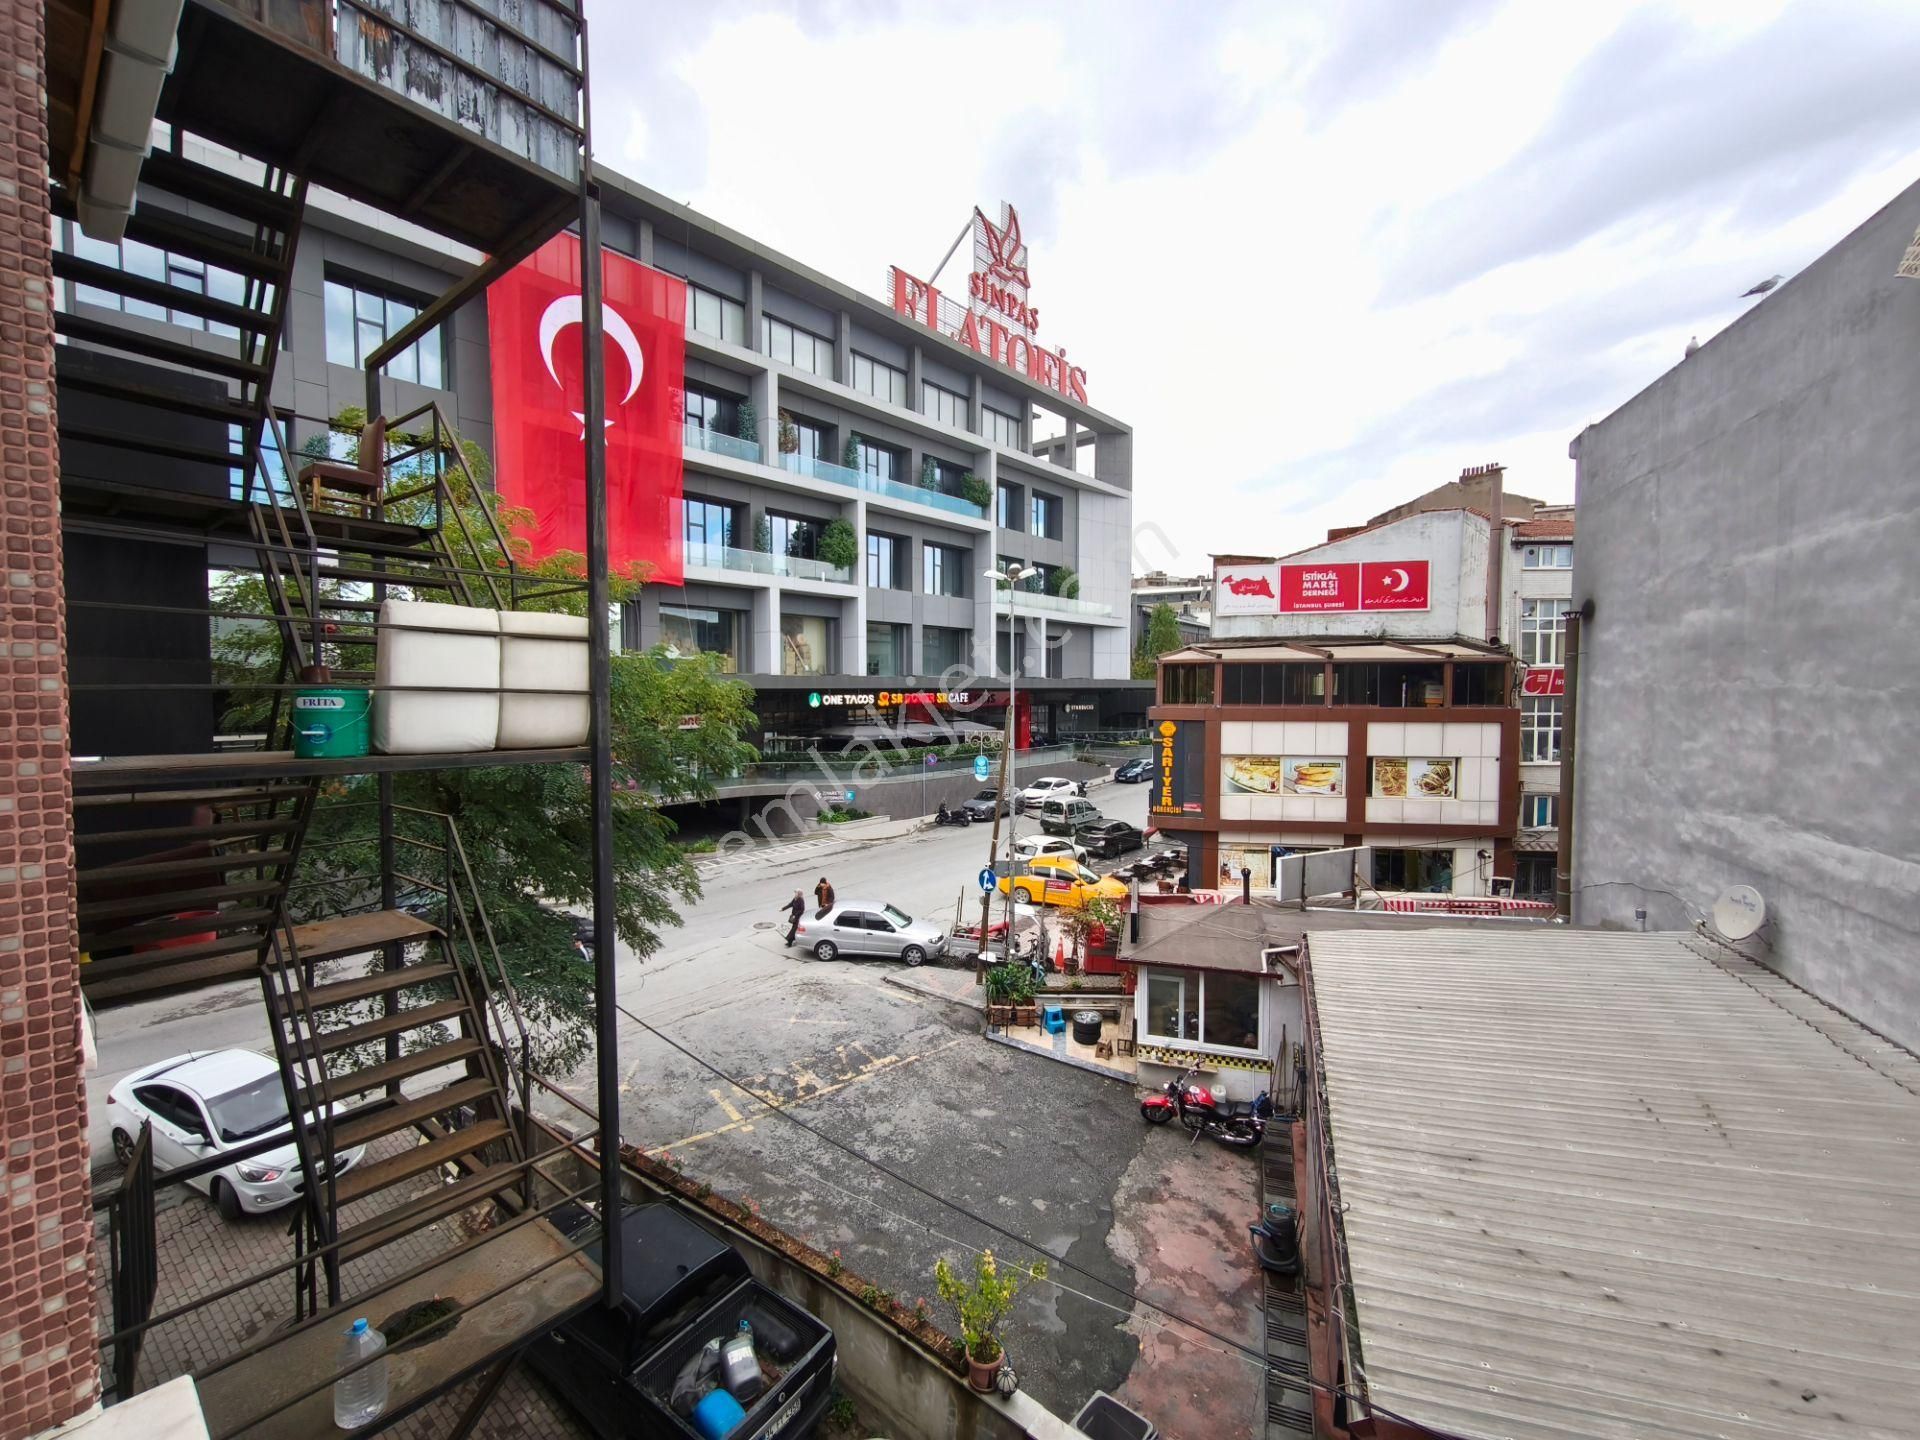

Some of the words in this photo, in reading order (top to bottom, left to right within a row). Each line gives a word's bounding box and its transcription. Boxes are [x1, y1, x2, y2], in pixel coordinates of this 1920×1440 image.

[970, 270, 1039, 336] SİNPAŞ
[822, 695, 844, 706] ONE
[844, 694, 875, 705] TACOS
[948, 692, 969, 704] CAFE
[1161, 737, 1174, 806] SARIYER
